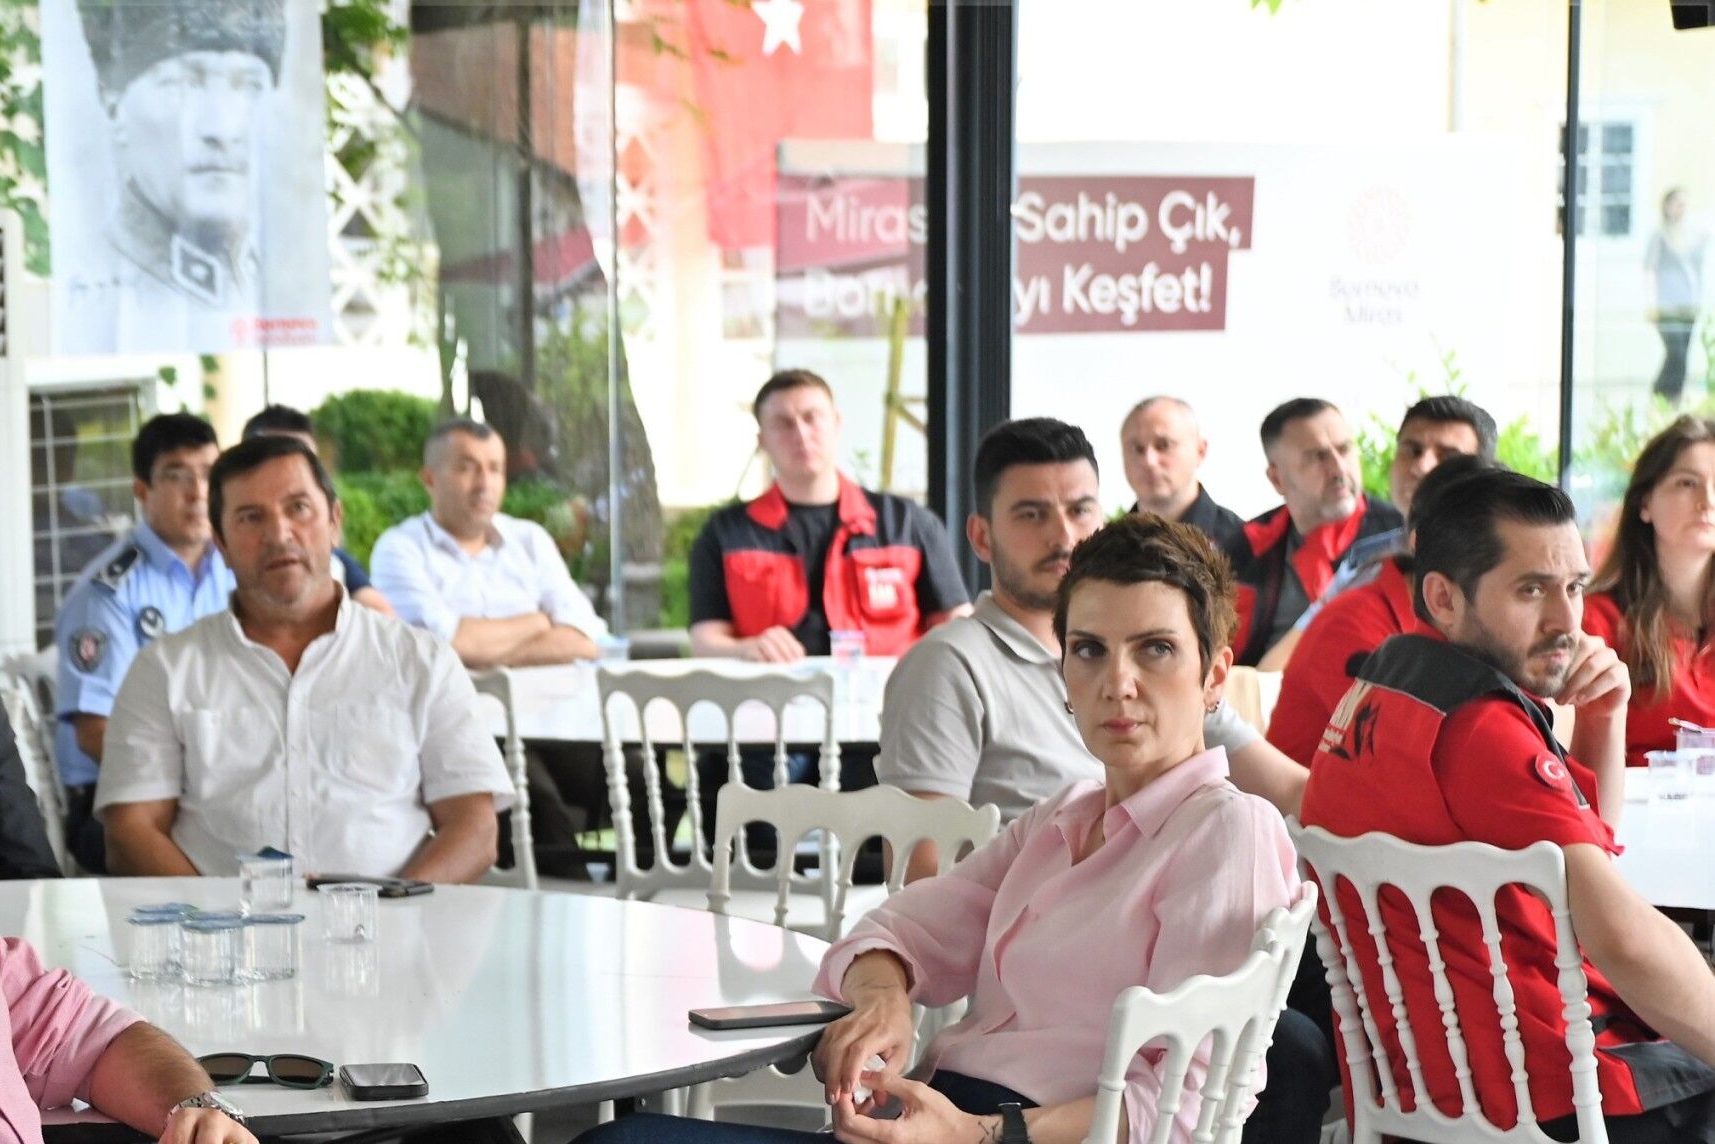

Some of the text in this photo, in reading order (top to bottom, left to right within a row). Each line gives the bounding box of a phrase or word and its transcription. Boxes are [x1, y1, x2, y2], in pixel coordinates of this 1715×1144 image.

[805, 190, 1242, 255] Miras Sahip Çık,
[1062, 260, 1213, 326] Keşfet!
